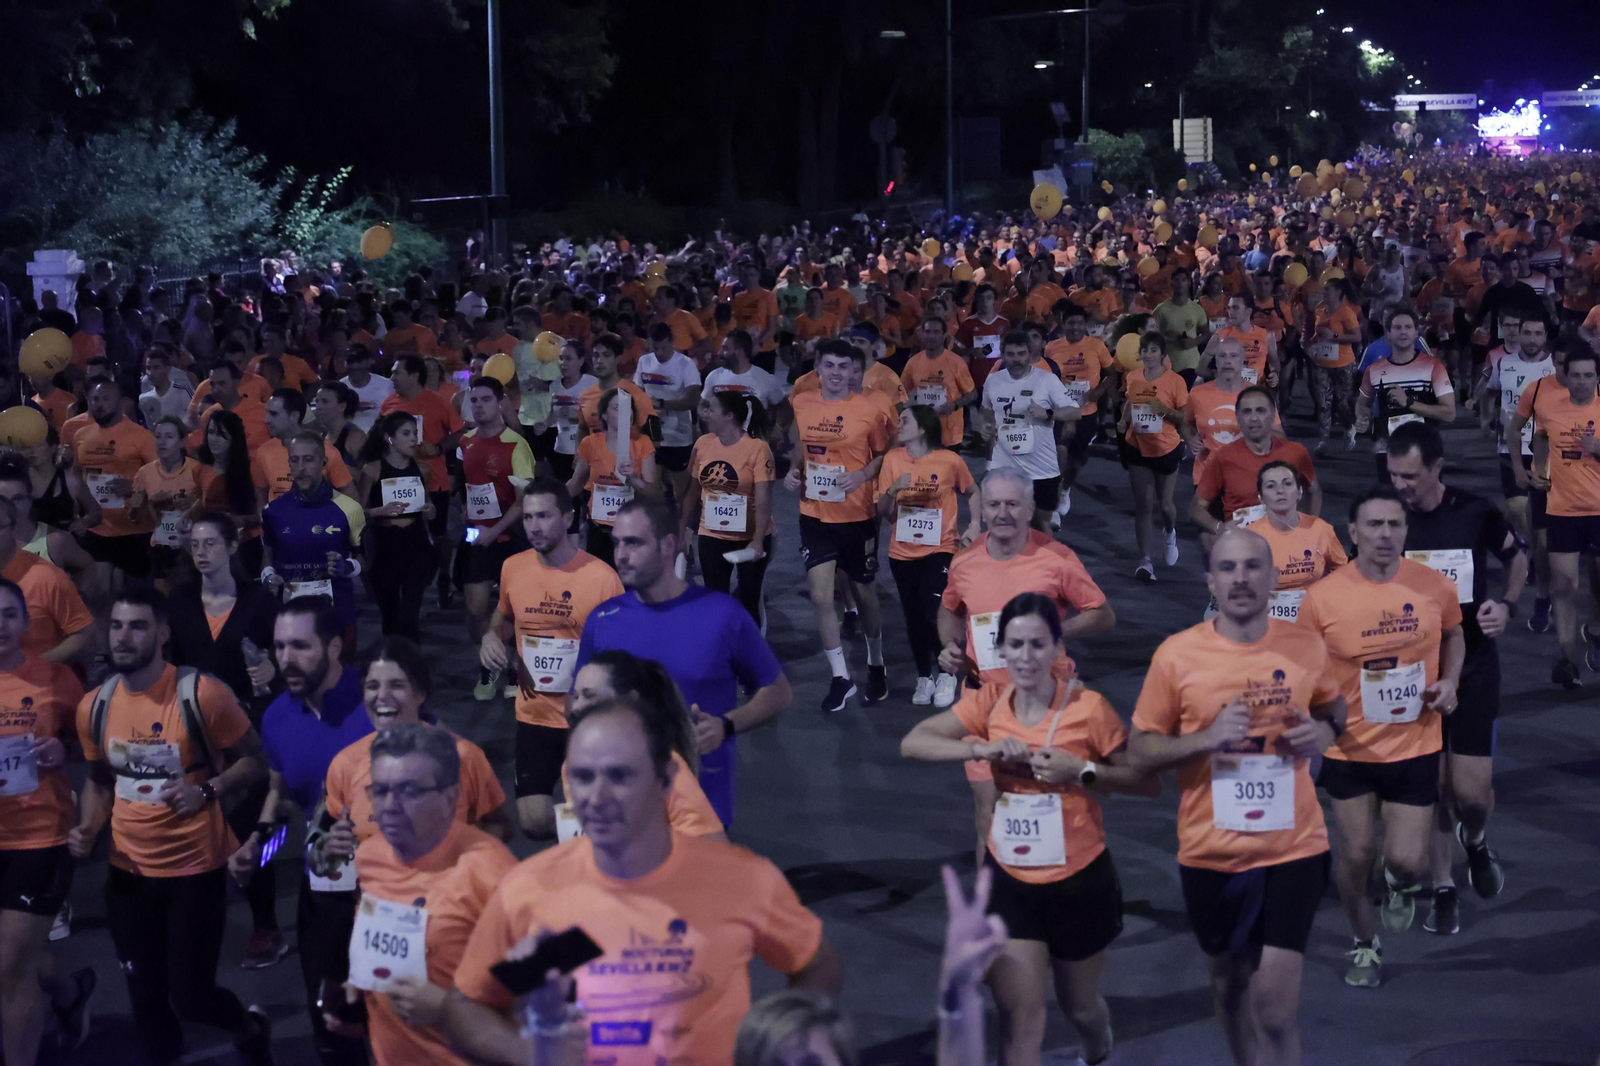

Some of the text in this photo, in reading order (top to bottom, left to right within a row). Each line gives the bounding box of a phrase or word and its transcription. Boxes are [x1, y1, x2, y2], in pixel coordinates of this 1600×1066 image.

[1136, 414, 1157, 422] 12775
[1006, 433, 1027, 442] 16692
[813, 476, 837, 487] 12374
[392, 488, 417, 499] 15561
[601, 497, 626, 506] 15144
[713, 506, 738, 517] 16421
[908, 518, 934, 530] 12373
[1286, 561, 1315, 569] NOCTURNA
[1438, 569, 1458, 582] 75
[524, 607, 554, 615] SEVILLA
[539, 601, 573, 610] NOCTURNA
[1270, 605, 1299, 617] 1985
[1379, 617, 1419, 627] NOCTURNA
[1361, 624, 1419, 638] SEVILLA KH7
[534, 656, 563, 670] 8677
[1243, 687, 1292, 698] NOCTURNA
[1378, 684, 1418, 701] 11240
[1235, 781, 1275, 800] 3033
[1006, 817, 1040, 836] 3031
[364, 928, 408, 959] 14509
[589, 961, 653, 975] SEVILLA
